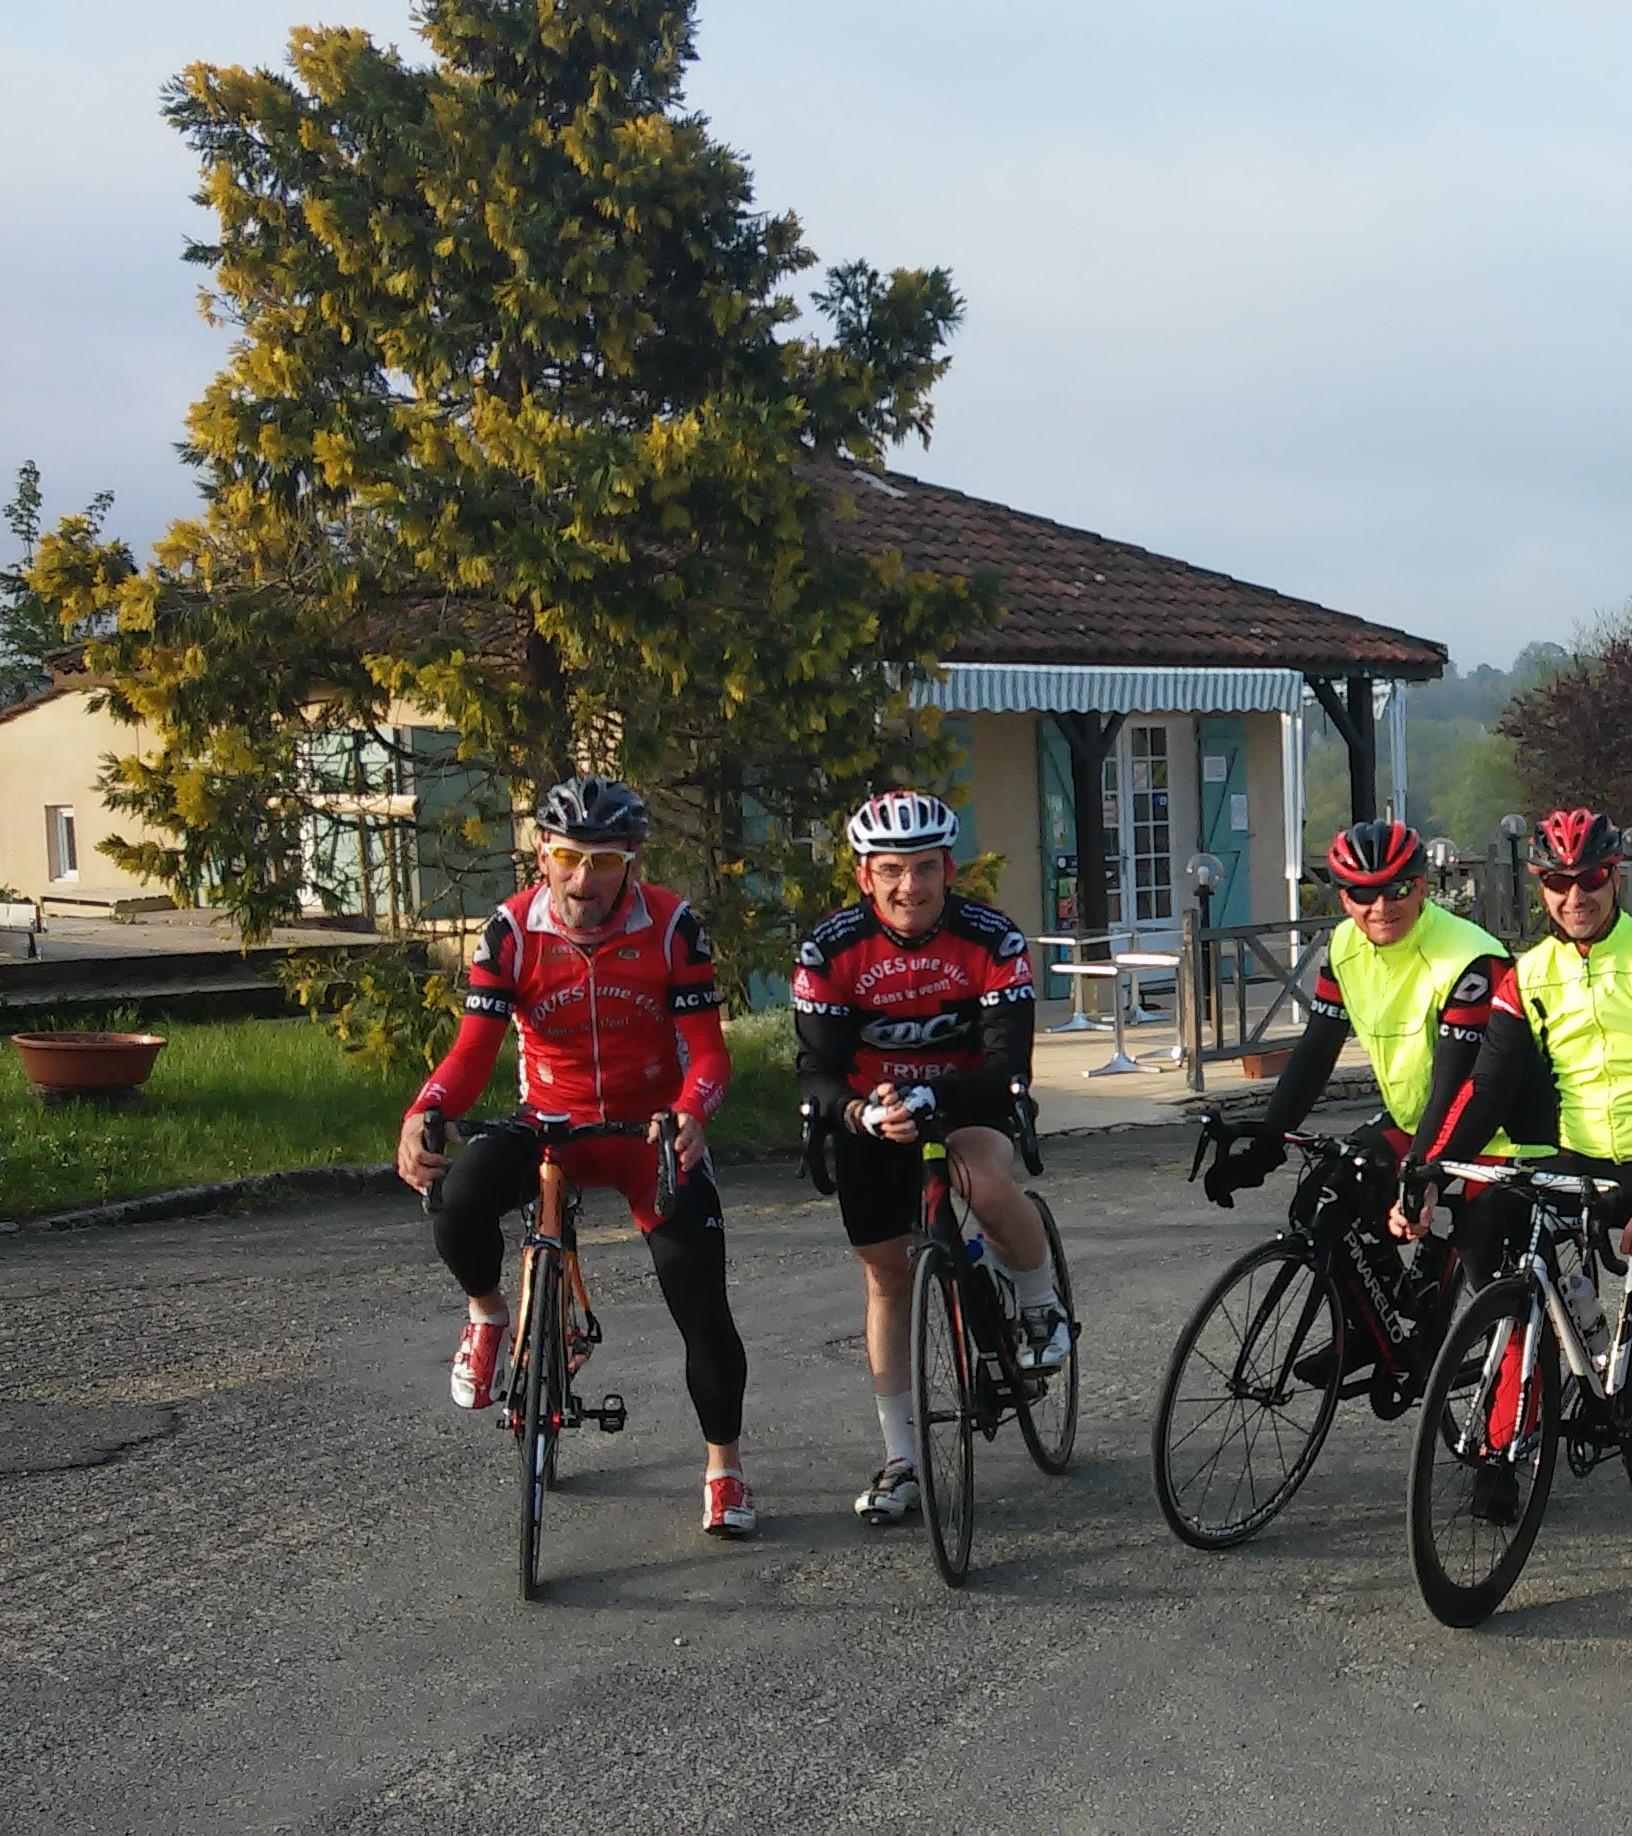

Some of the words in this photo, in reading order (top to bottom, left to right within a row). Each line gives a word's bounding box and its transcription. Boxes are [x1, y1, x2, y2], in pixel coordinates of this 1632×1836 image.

[855, 956, 907, 995] VOVES
[910, 957, 941, 971] une
[595, 985, 632, 1000] une
[673, 993, 700, 1009] AC
[872, 993, 904, 1006] dans
[881, 1061, 959, 1081] TRYBA
[1342, 1229, 1404, 1344] PINARELLO
